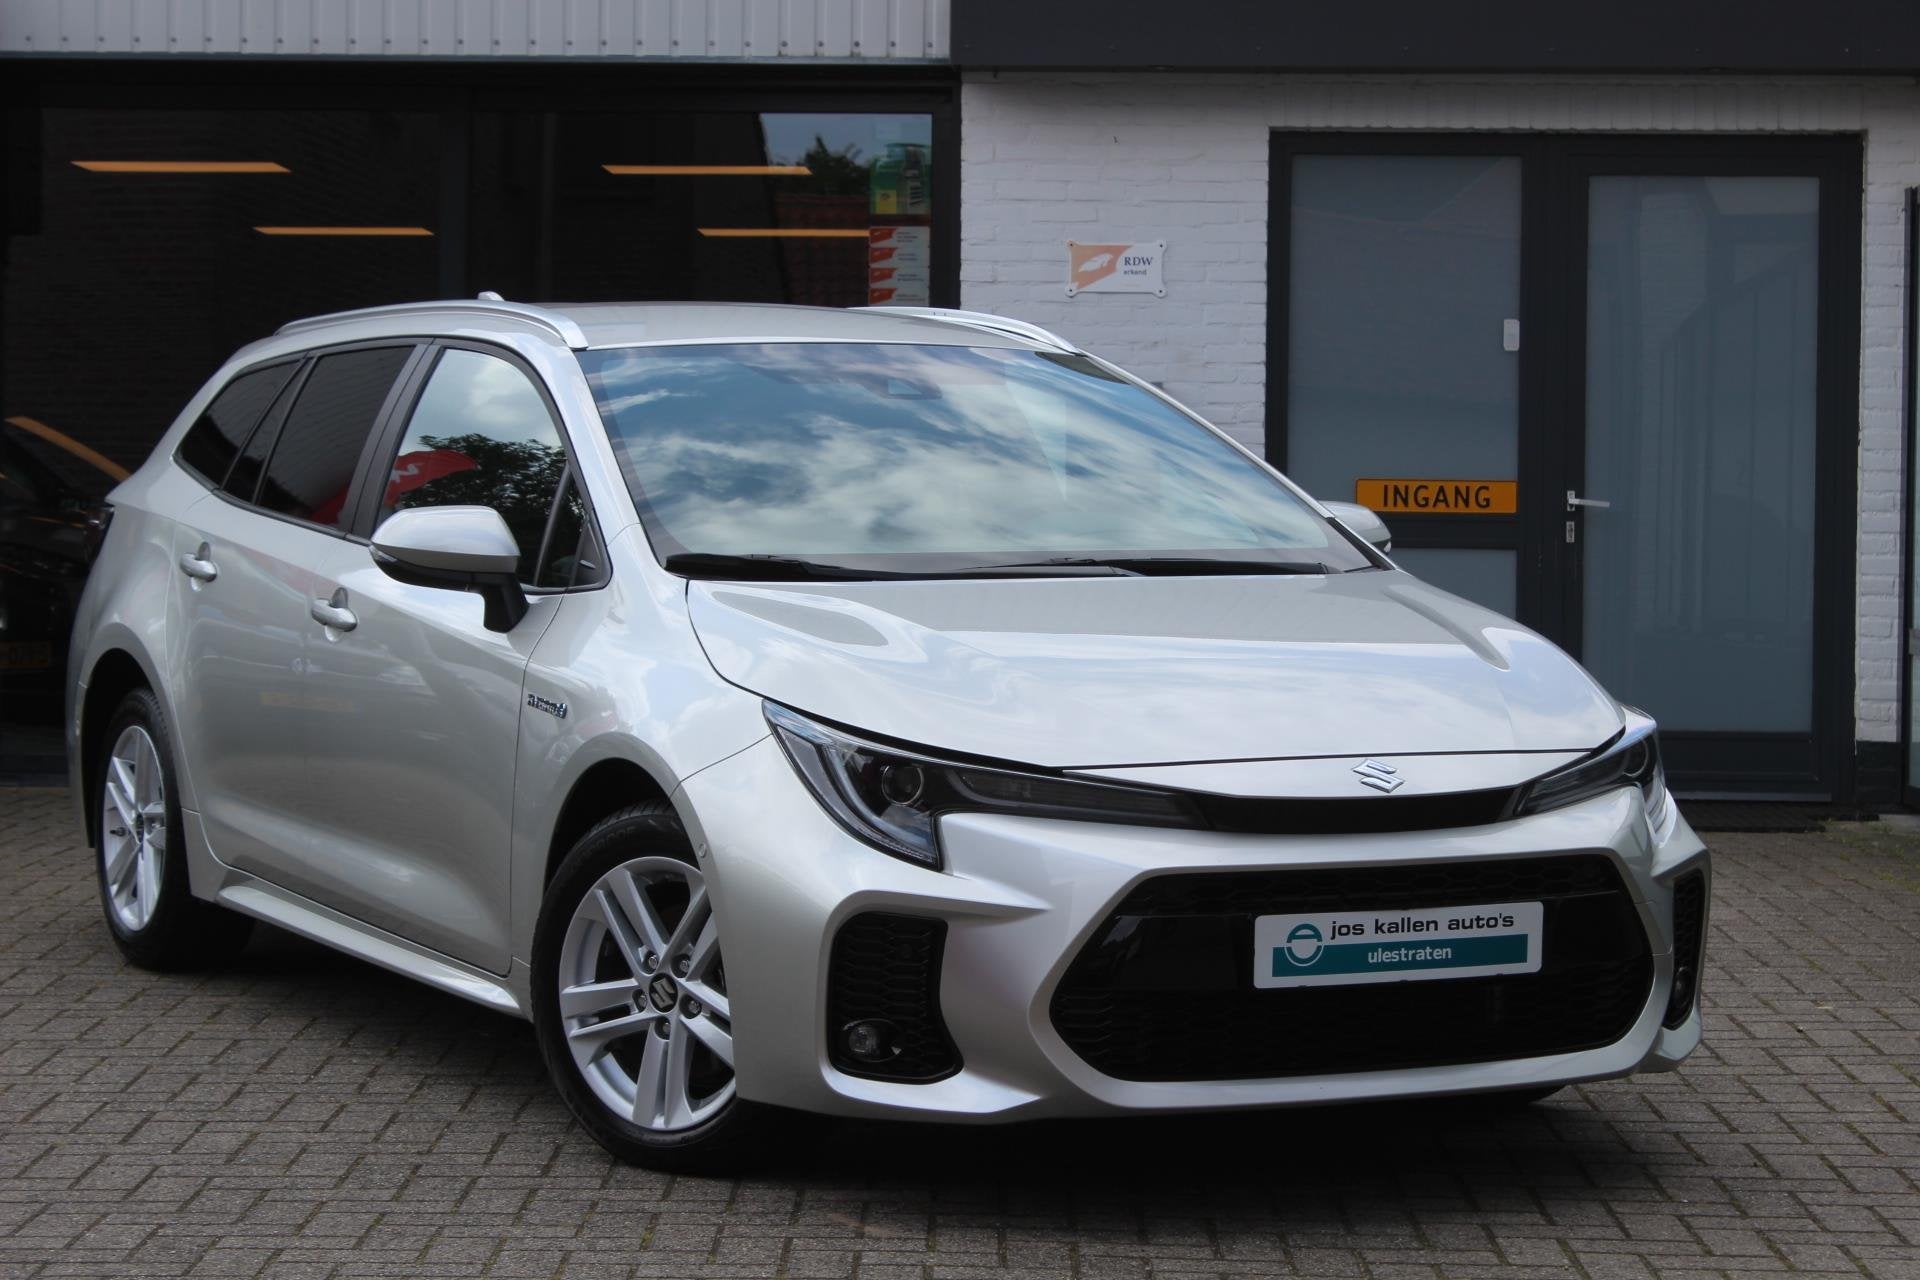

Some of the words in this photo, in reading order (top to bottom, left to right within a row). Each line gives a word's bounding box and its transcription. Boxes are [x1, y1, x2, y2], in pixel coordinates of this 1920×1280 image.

[1124, 256, 1153, 266] RDW
[1383, 484, 1490, 508] INGANG
[1330, 920, 1365, 940] jos
[1374, 917, 1438, 935] kallen
[1447, 913, 1514, 931] auto's
[1368, 946, 1452, 964] ulestraten
